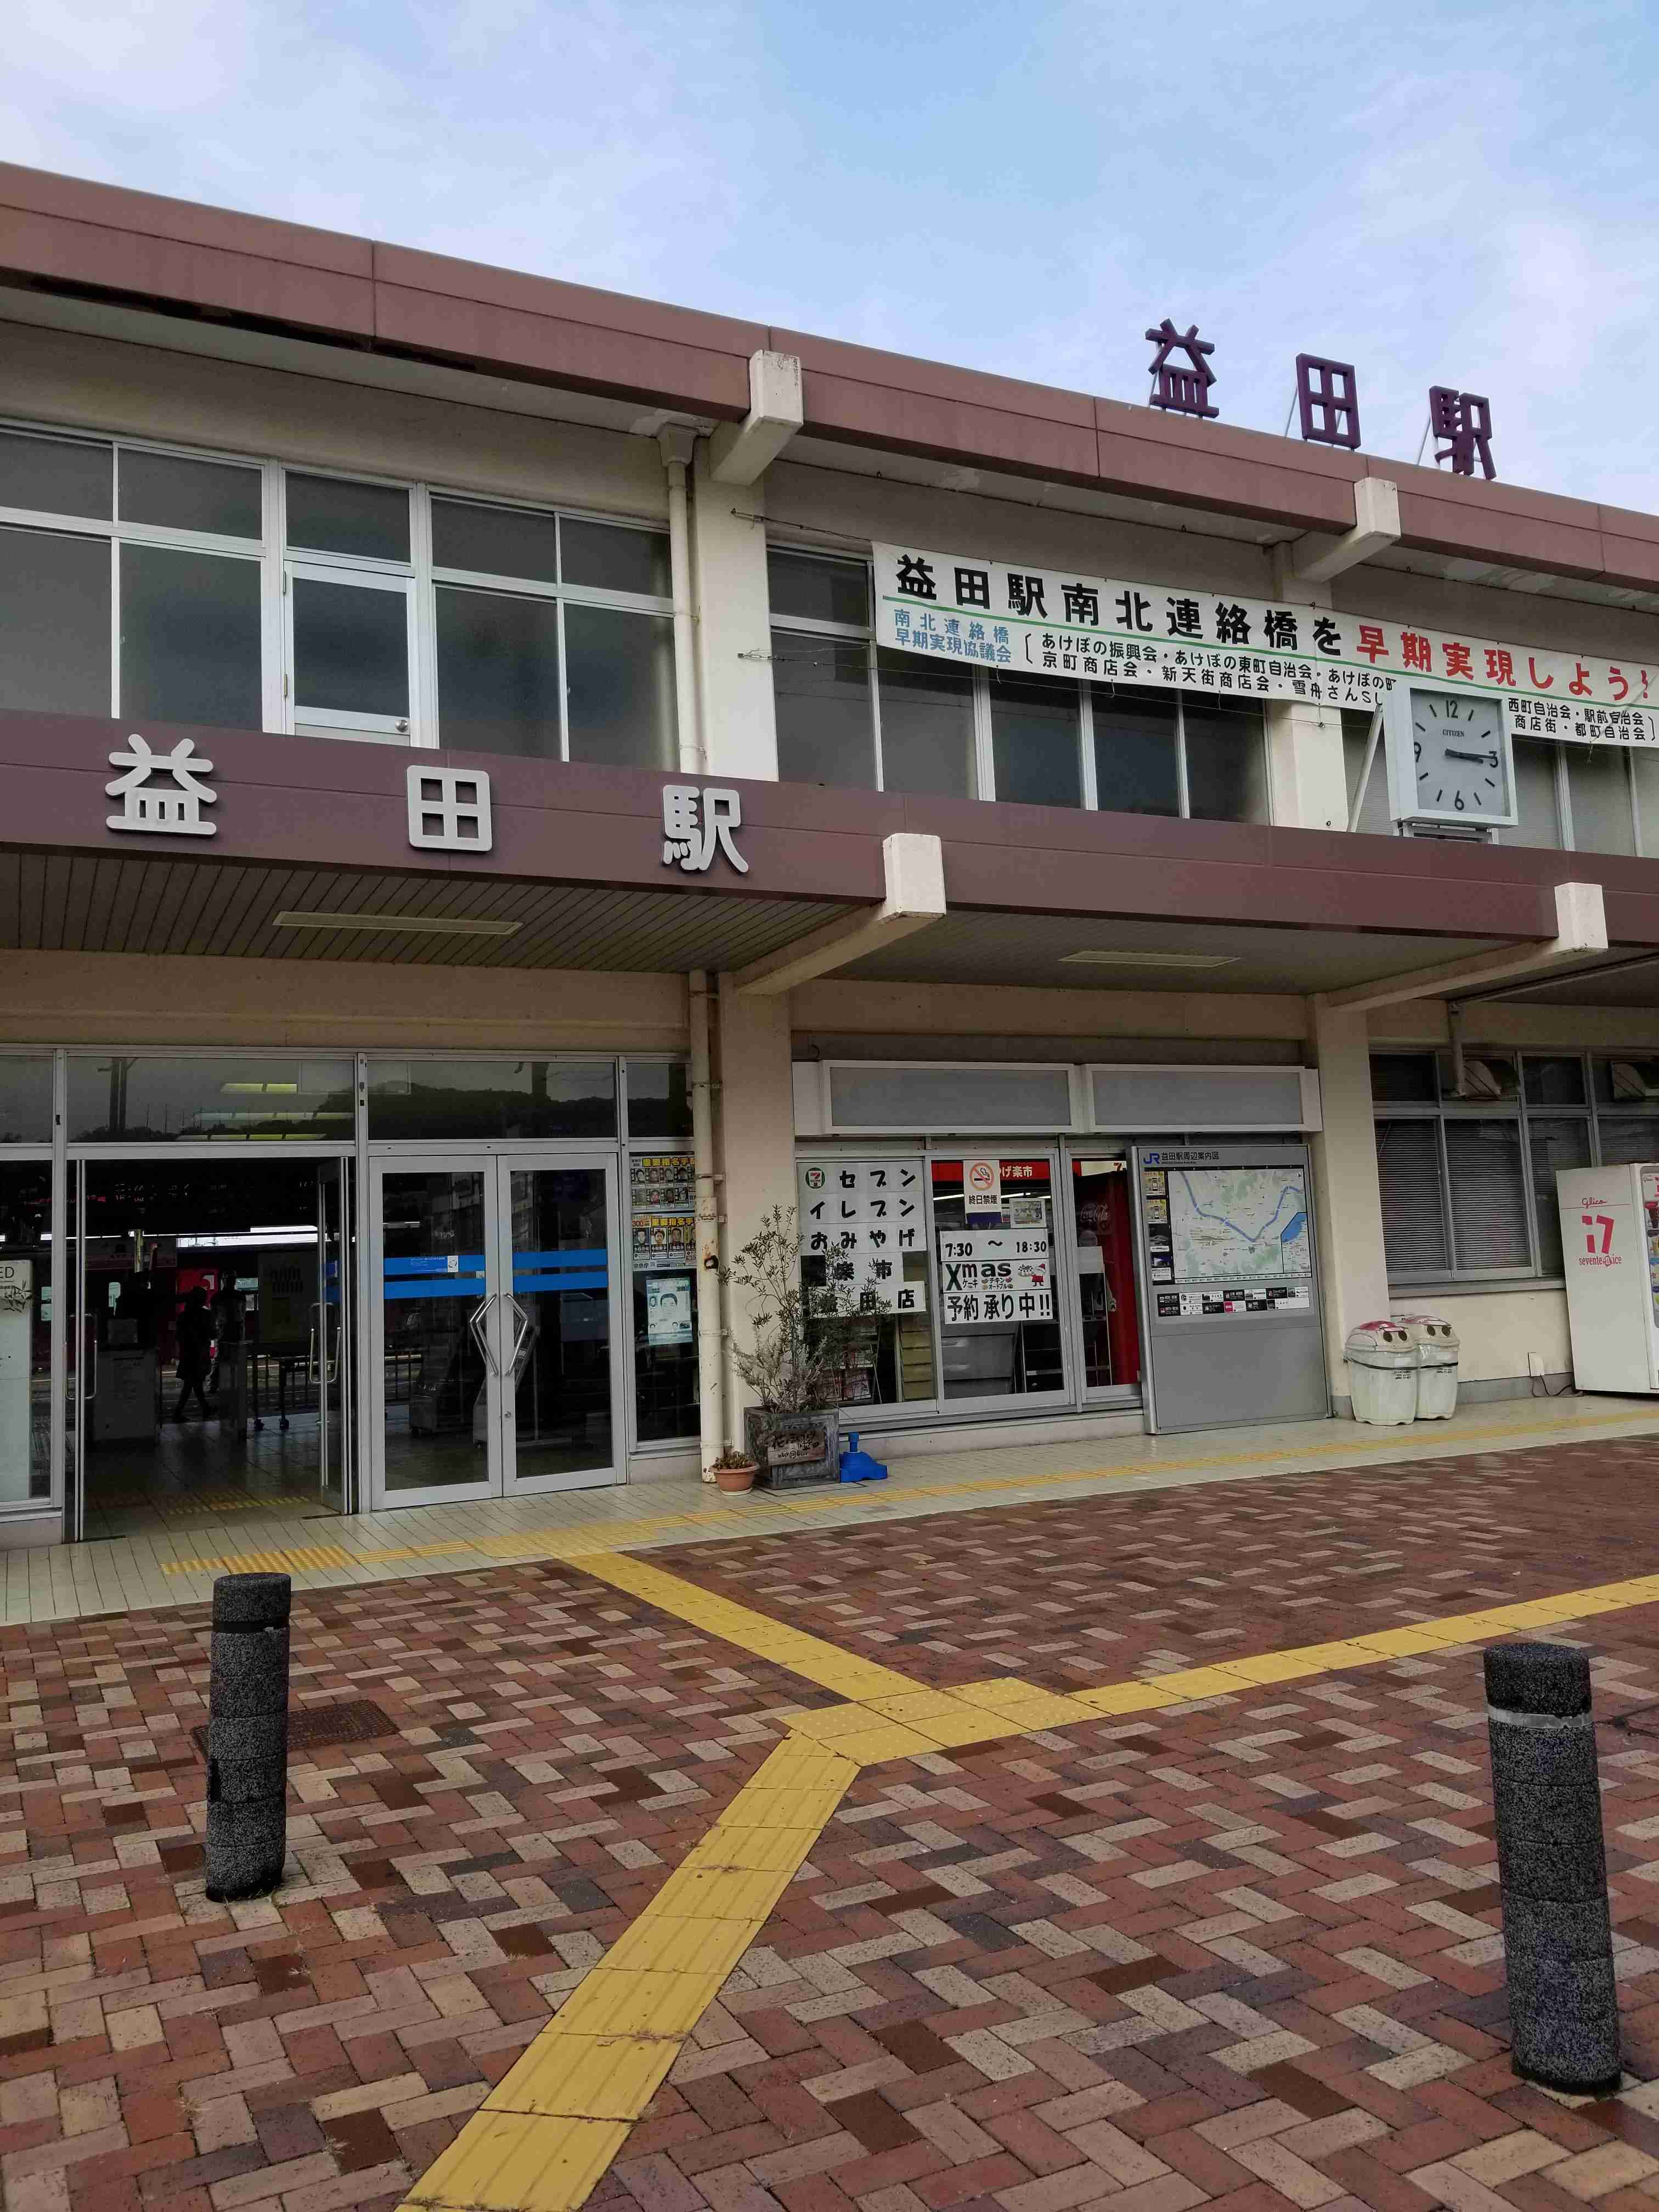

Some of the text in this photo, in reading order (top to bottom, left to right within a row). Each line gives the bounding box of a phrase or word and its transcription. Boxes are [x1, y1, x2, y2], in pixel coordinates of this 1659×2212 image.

[1145, 318, 1497, 481] 益田駅
[894, 608, 1009, 645] 南北連絡橋
[895, 628, 1012, 663] 早期実現協議会
[1446, 699, 1459, 719] 12
[1442, 729, 1465, 738] CITIZEN
[1413, 742, 1422, 763] 9
[1488, 751, 1499, 768] 3
[105, 733, 749, 874] 益田駅
[1454, 790, 1465, 811] 6
[1143, 1153, 1160, 1164] JR
[839, 1169, 916, 1189] セブン
[810, 1199, 915, 1220] イレブン
[969, 1194, 998, 1205] 終日禁煙
[1582, 1197, 1607, 1209] Glico
[811, 1228, 915, 1250] おみやげ
[1582, 1215, 1615, 1254] 17
[945, 1242, 973, 1257] 7:30
[1016, 1241, 1047, 1253] 18:30
[945, 1263, 1012, 1290] Xmas
[962, 1278, 978, 1288] ケーキ
[947, 1292, 1051, 1322] 予約承り中!!
